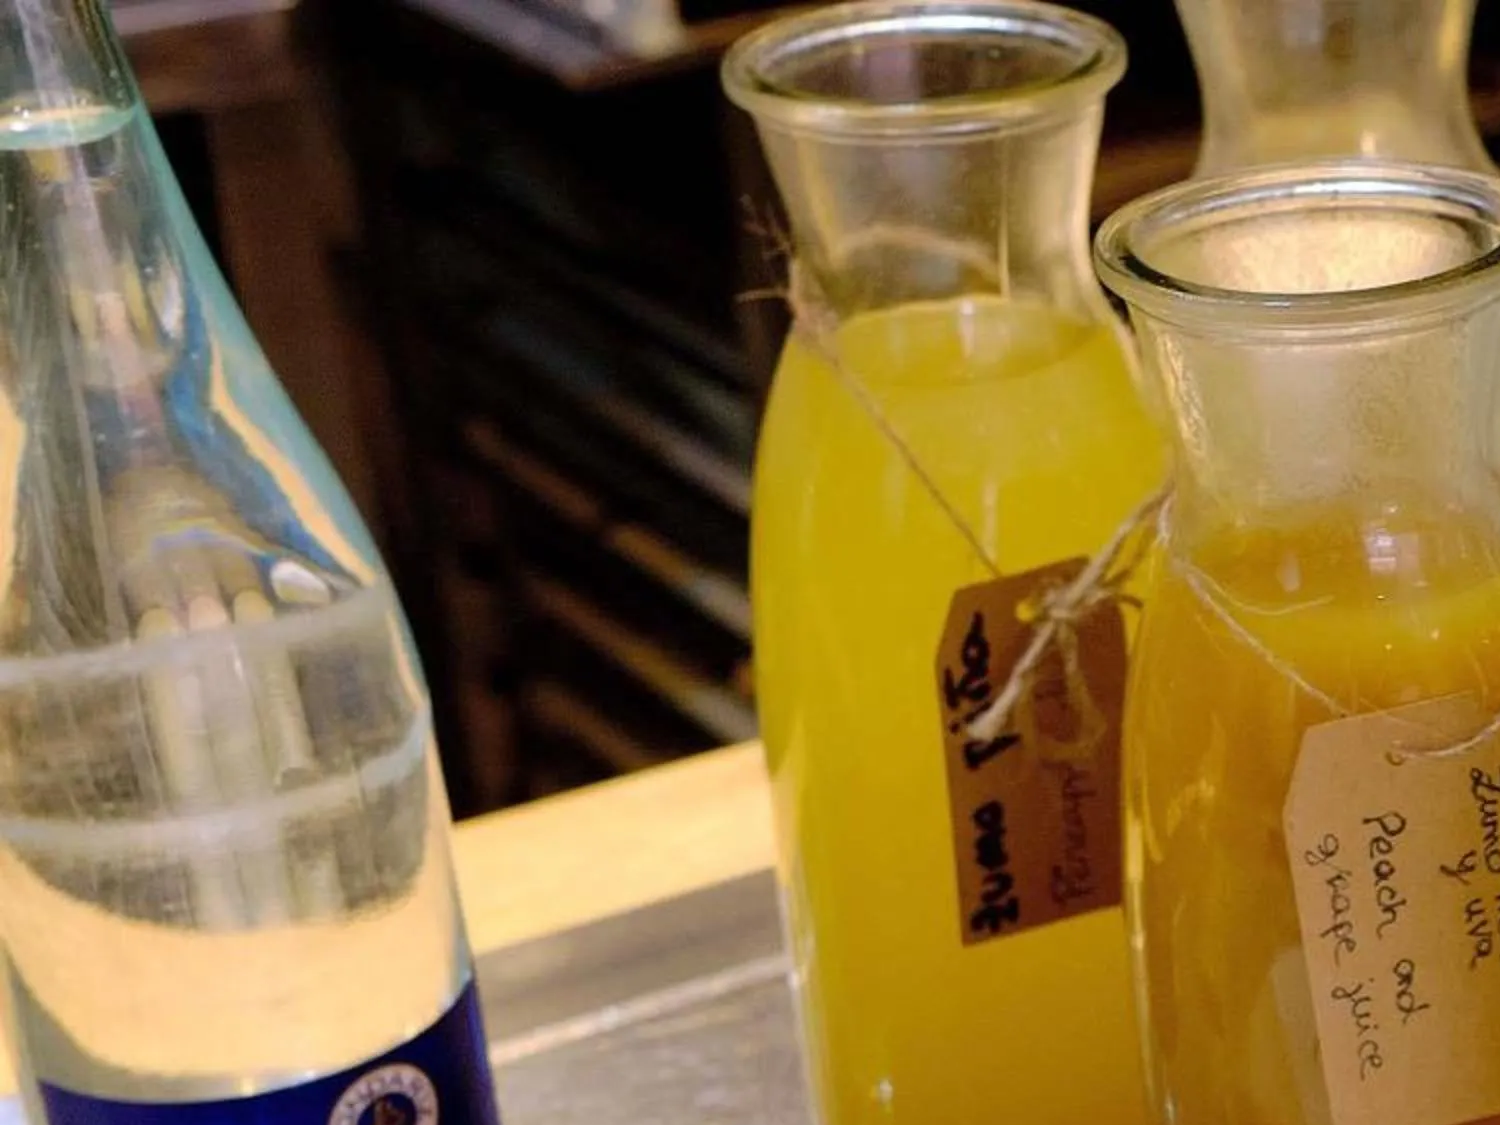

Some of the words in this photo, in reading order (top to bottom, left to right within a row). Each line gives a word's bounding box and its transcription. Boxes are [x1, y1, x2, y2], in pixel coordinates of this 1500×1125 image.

[1304, 832, 1357, 968] grape
[1331, 976, 1384, 1082] juice
[1362, 810, 1407, 941] Peach
[1392, 957, 1430, 1025] and
[1440, 848, 1478, 886] y
[1464, 897, 1493, 971] uva
